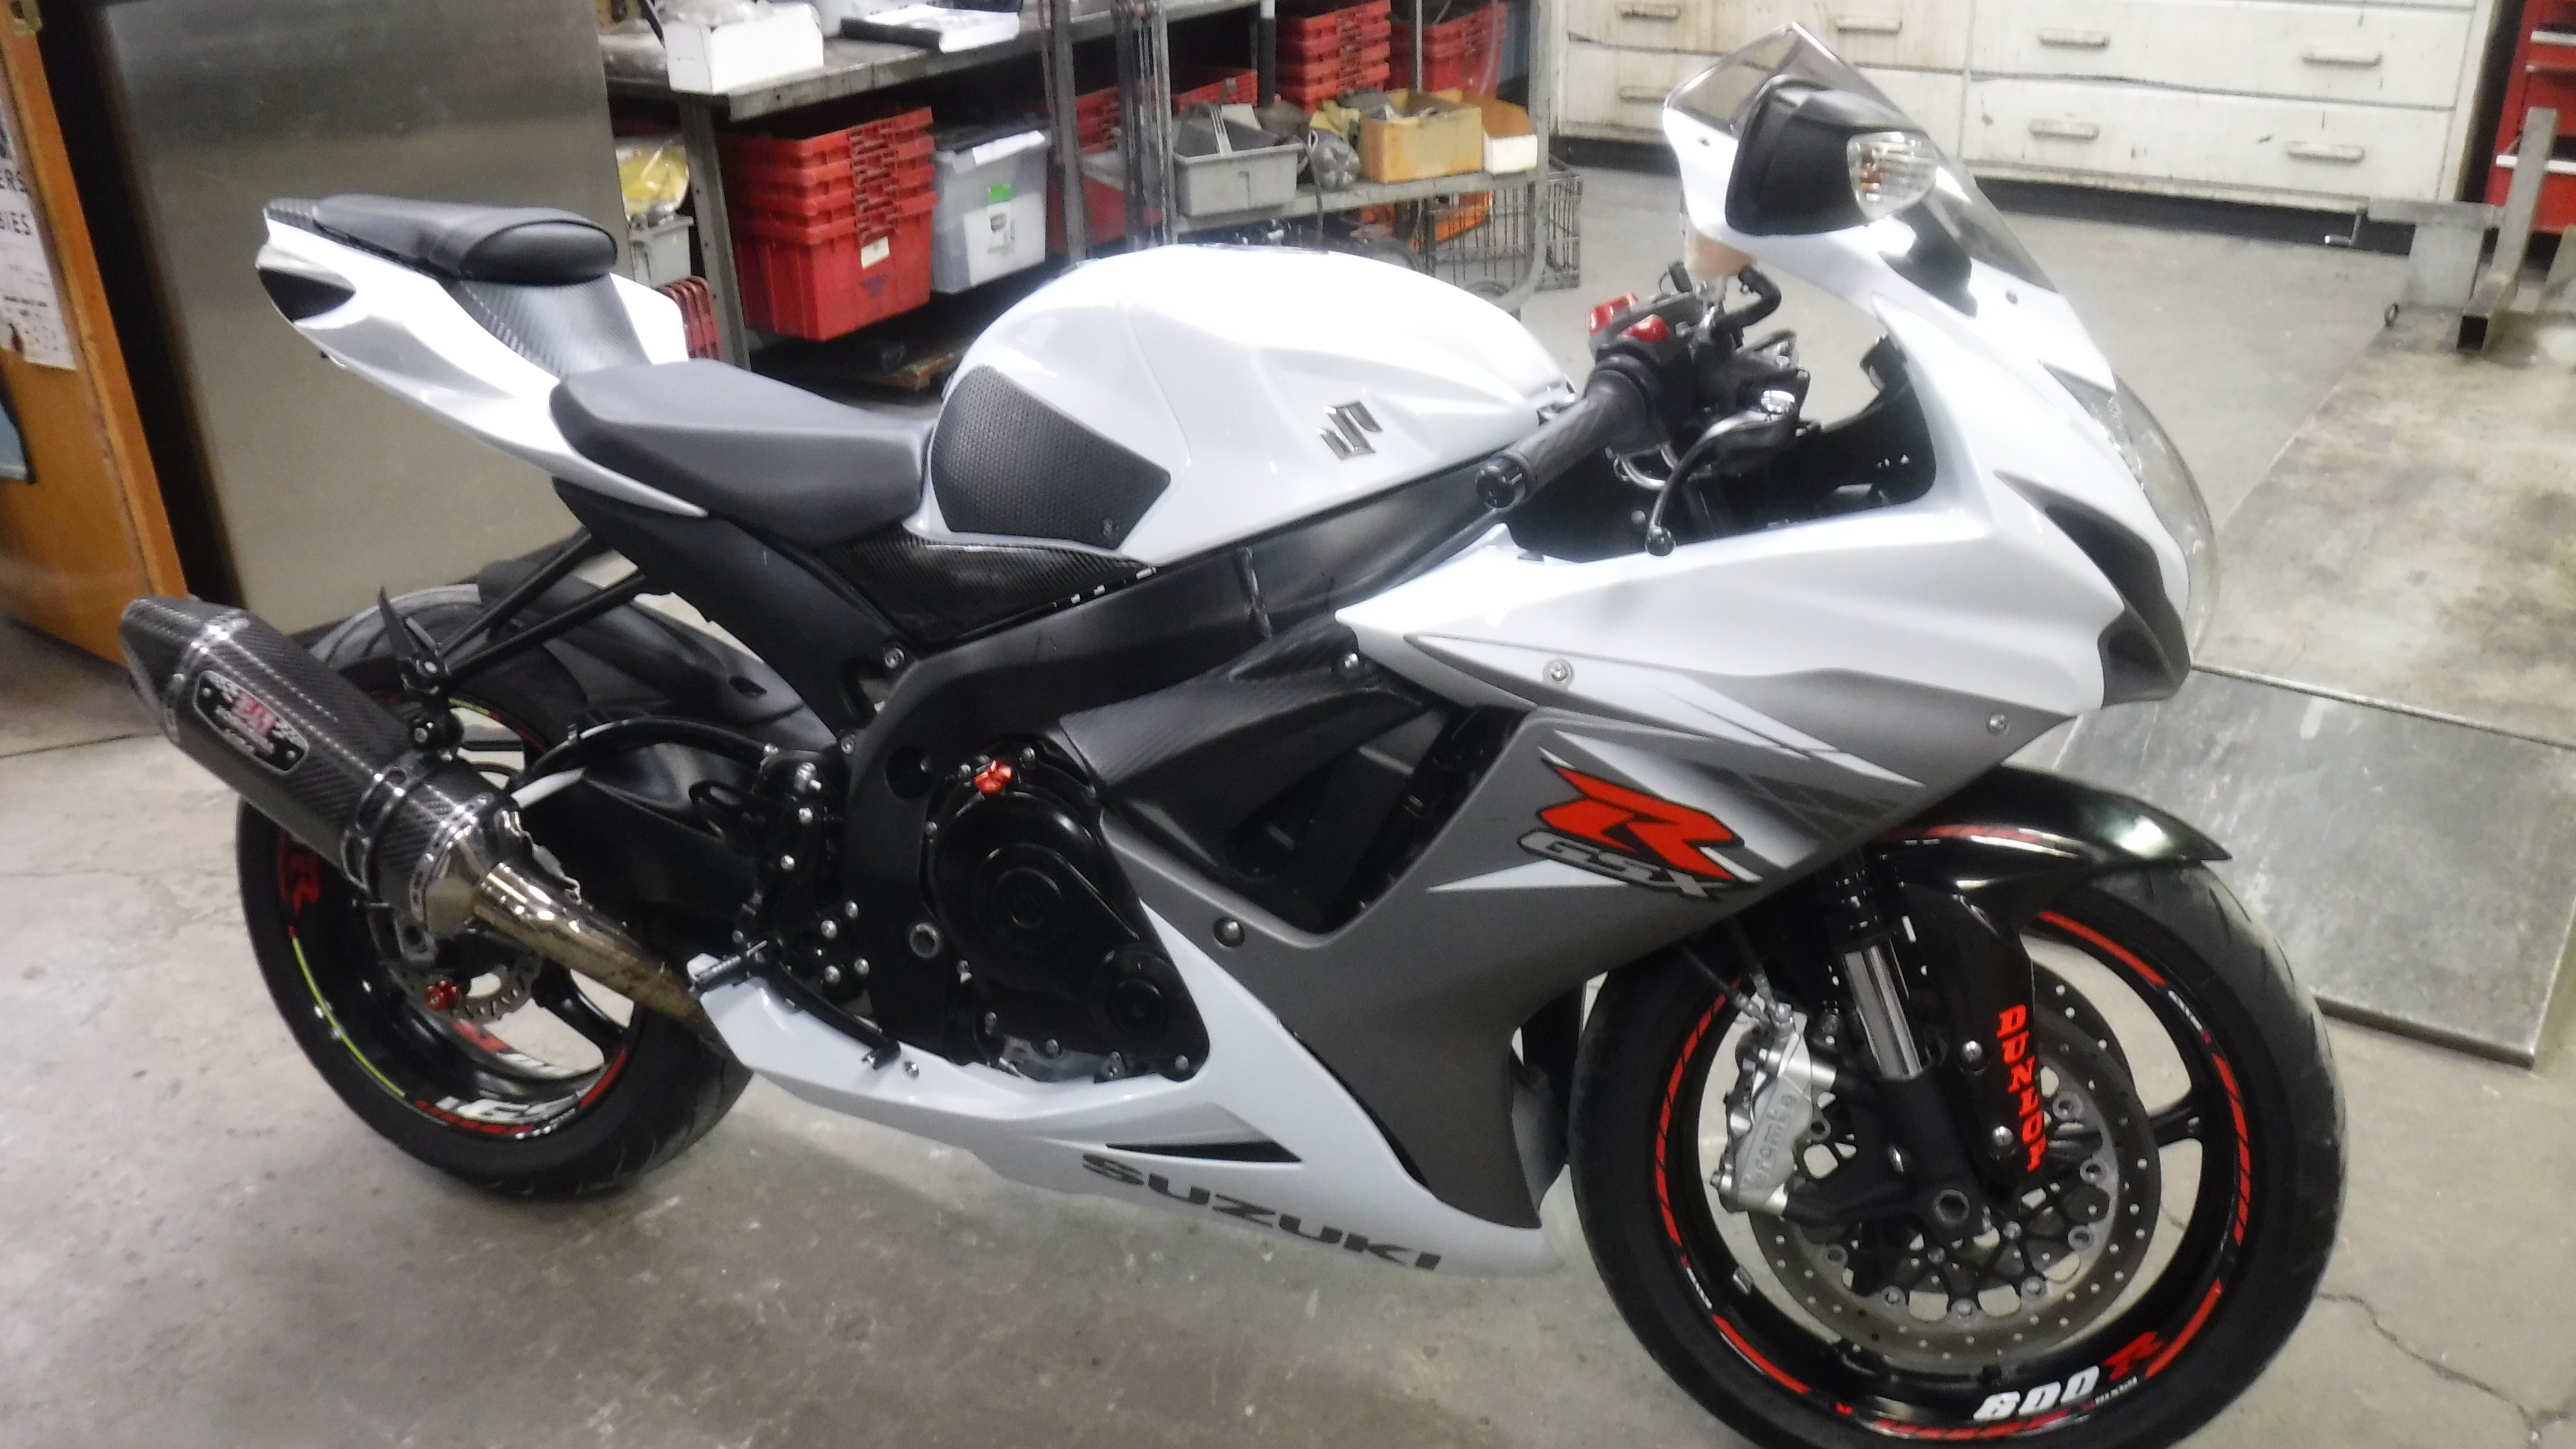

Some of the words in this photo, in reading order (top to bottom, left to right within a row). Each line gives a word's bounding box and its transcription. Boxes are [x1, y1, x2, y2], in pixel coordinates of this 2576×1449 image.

[1996, 1003, 2048, 1171] DUNLOP
[1082, 1153, 1442, 1271] SUZUKI
[1973, 1365, 2100, 1420] 600
